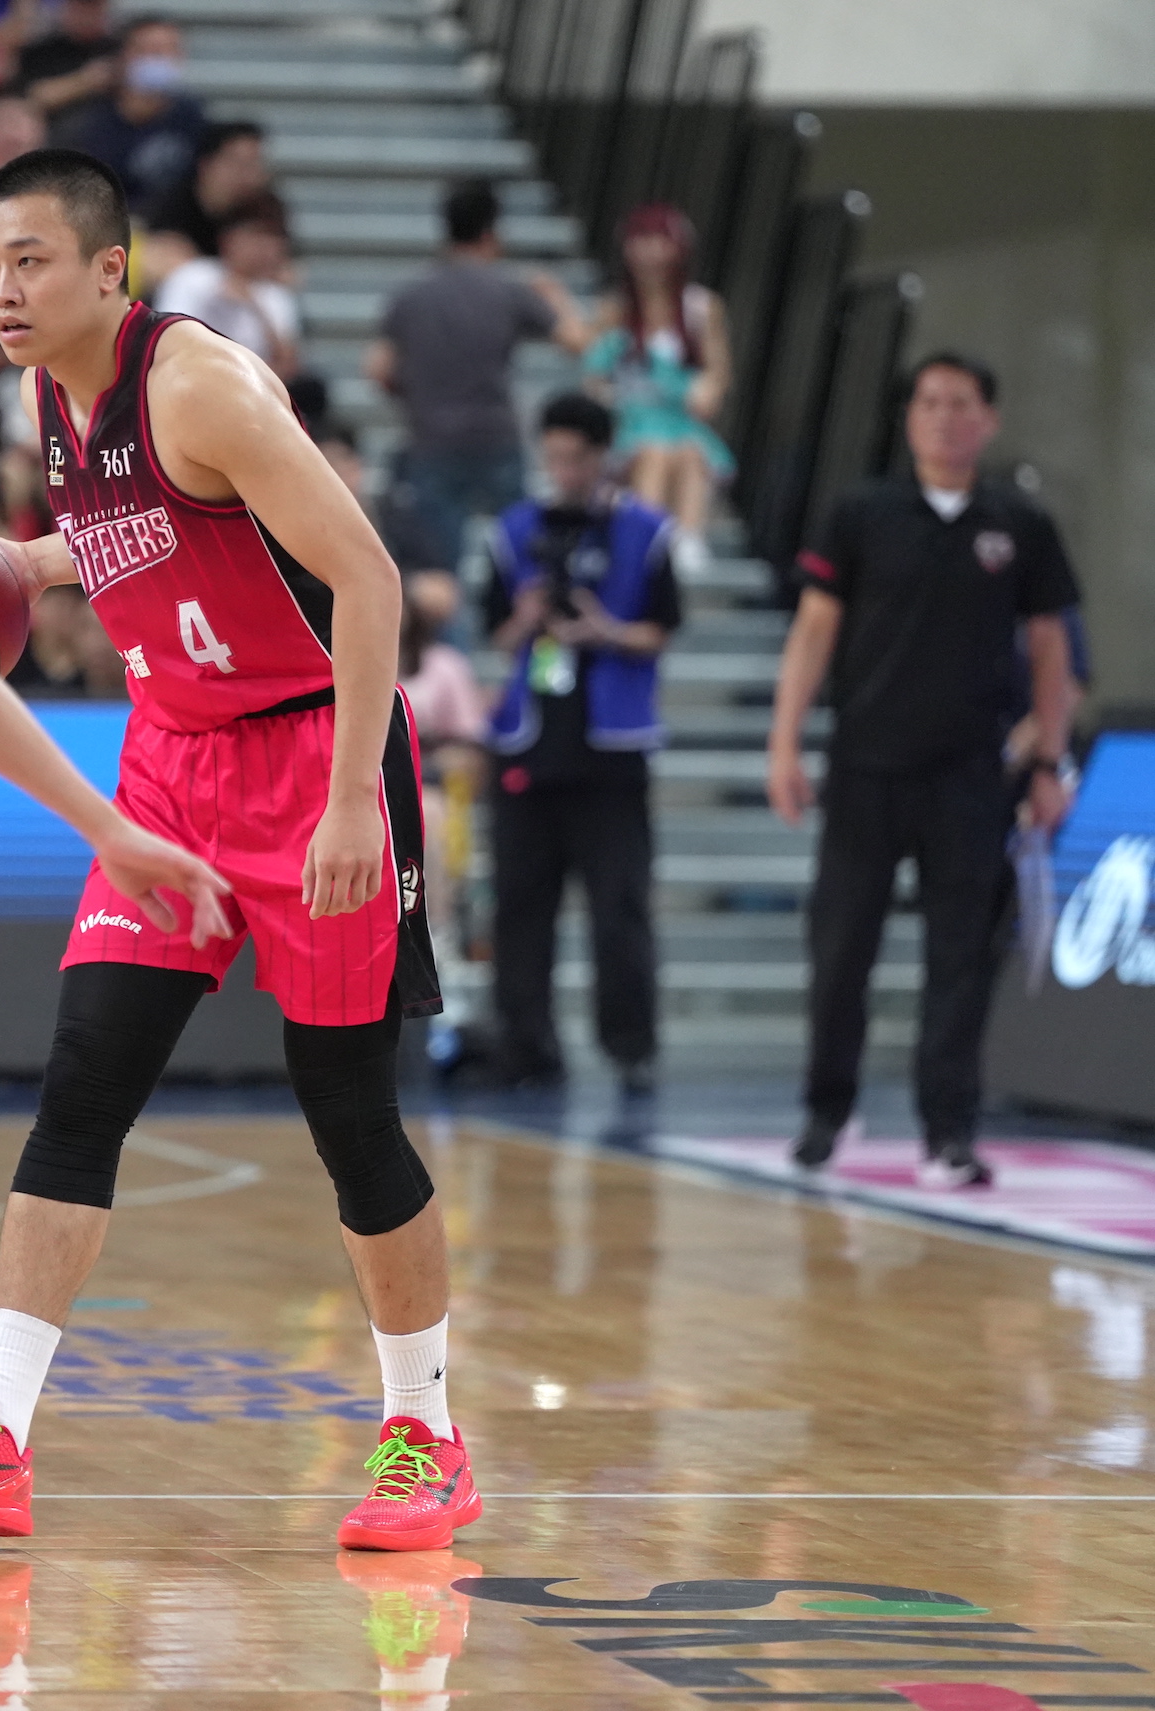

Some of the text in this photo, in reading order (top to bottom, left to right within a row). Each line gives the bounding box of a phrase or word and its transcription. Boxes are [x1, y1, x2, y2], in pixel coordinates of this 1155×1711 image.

[73, 503, 135, 528] KAOHSIUNG
[176, 597, 237, 674] 4
[79, 908, 143, 934] Woden
